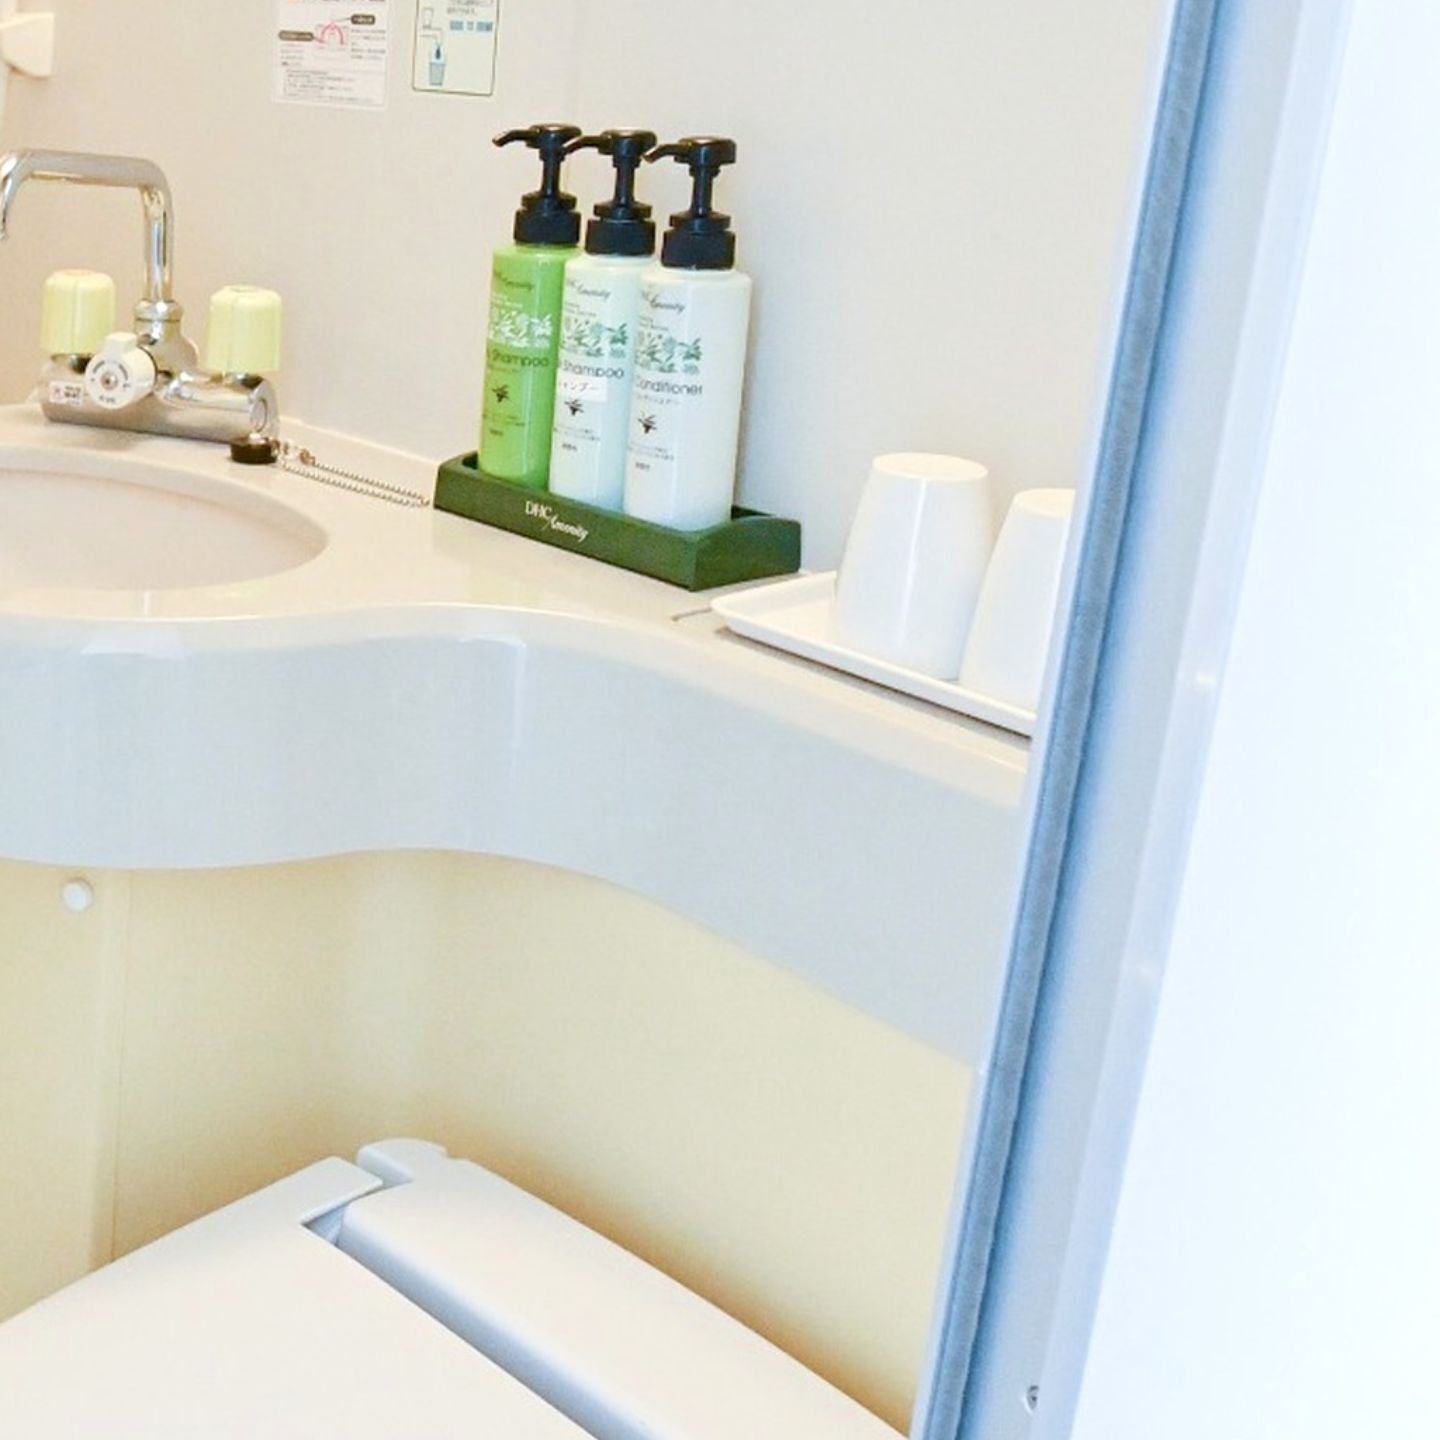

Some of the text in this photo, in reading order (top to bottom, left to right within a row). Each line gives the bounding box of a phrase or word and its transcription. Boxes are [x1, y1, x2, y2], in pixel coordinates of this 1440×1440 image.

[492, 348, 549, 367] Shampoo
[563, 360, 625, 380] Shampoo
[525, 500, 589, 542] DHC Amenity
